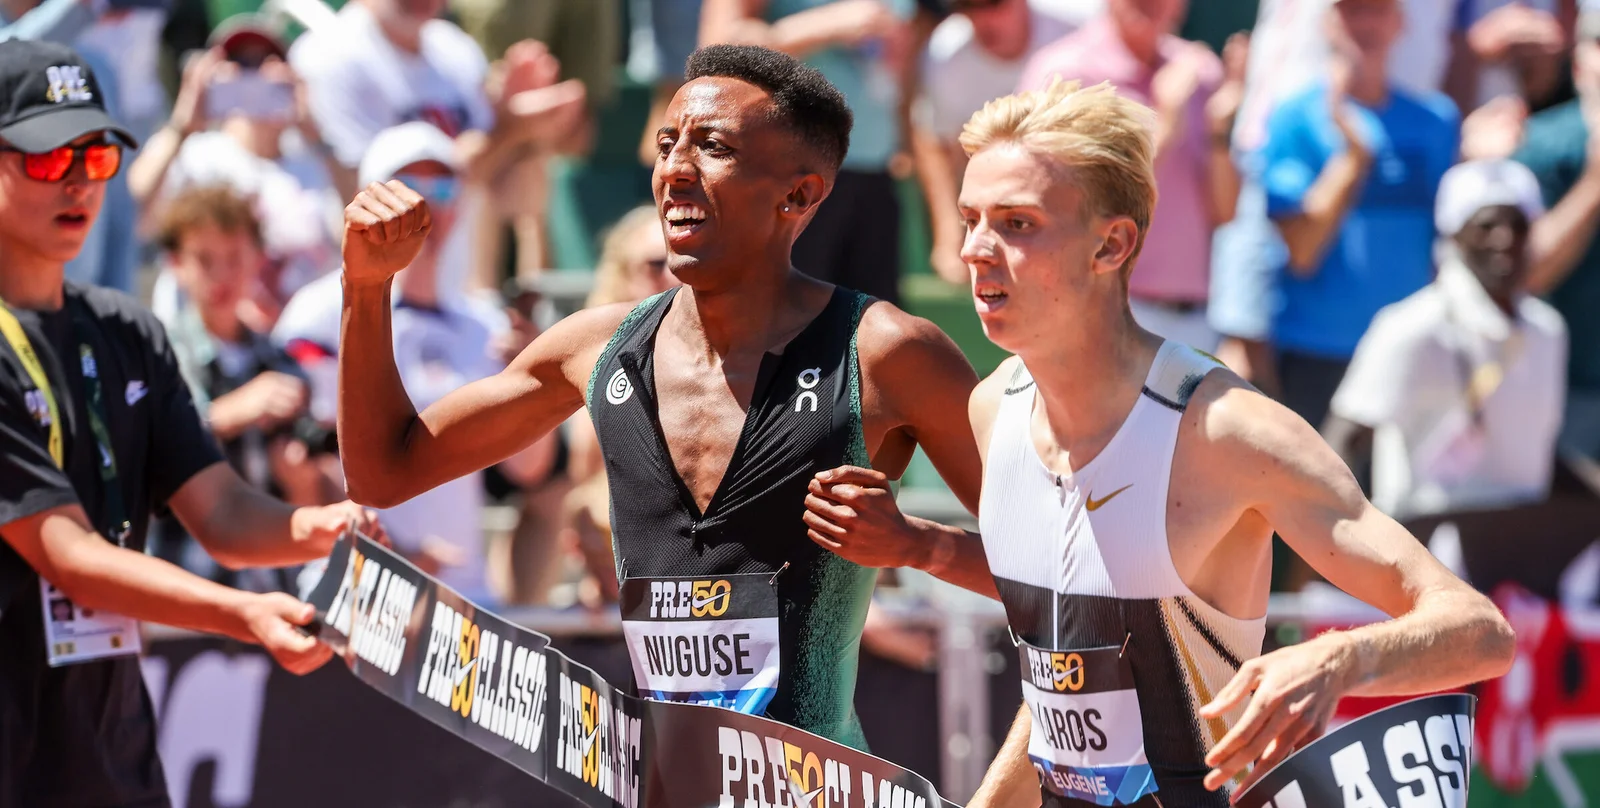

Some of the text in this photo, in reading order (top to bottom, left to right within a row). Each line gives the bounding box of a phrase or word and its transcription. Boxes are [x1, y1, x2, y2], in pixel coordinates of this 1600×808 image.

[643, 633, 754, 677] NUGUSE
[1037, 702, 1108, 752] LAROS
[1050, 769, 1109, 796] EUGENE
